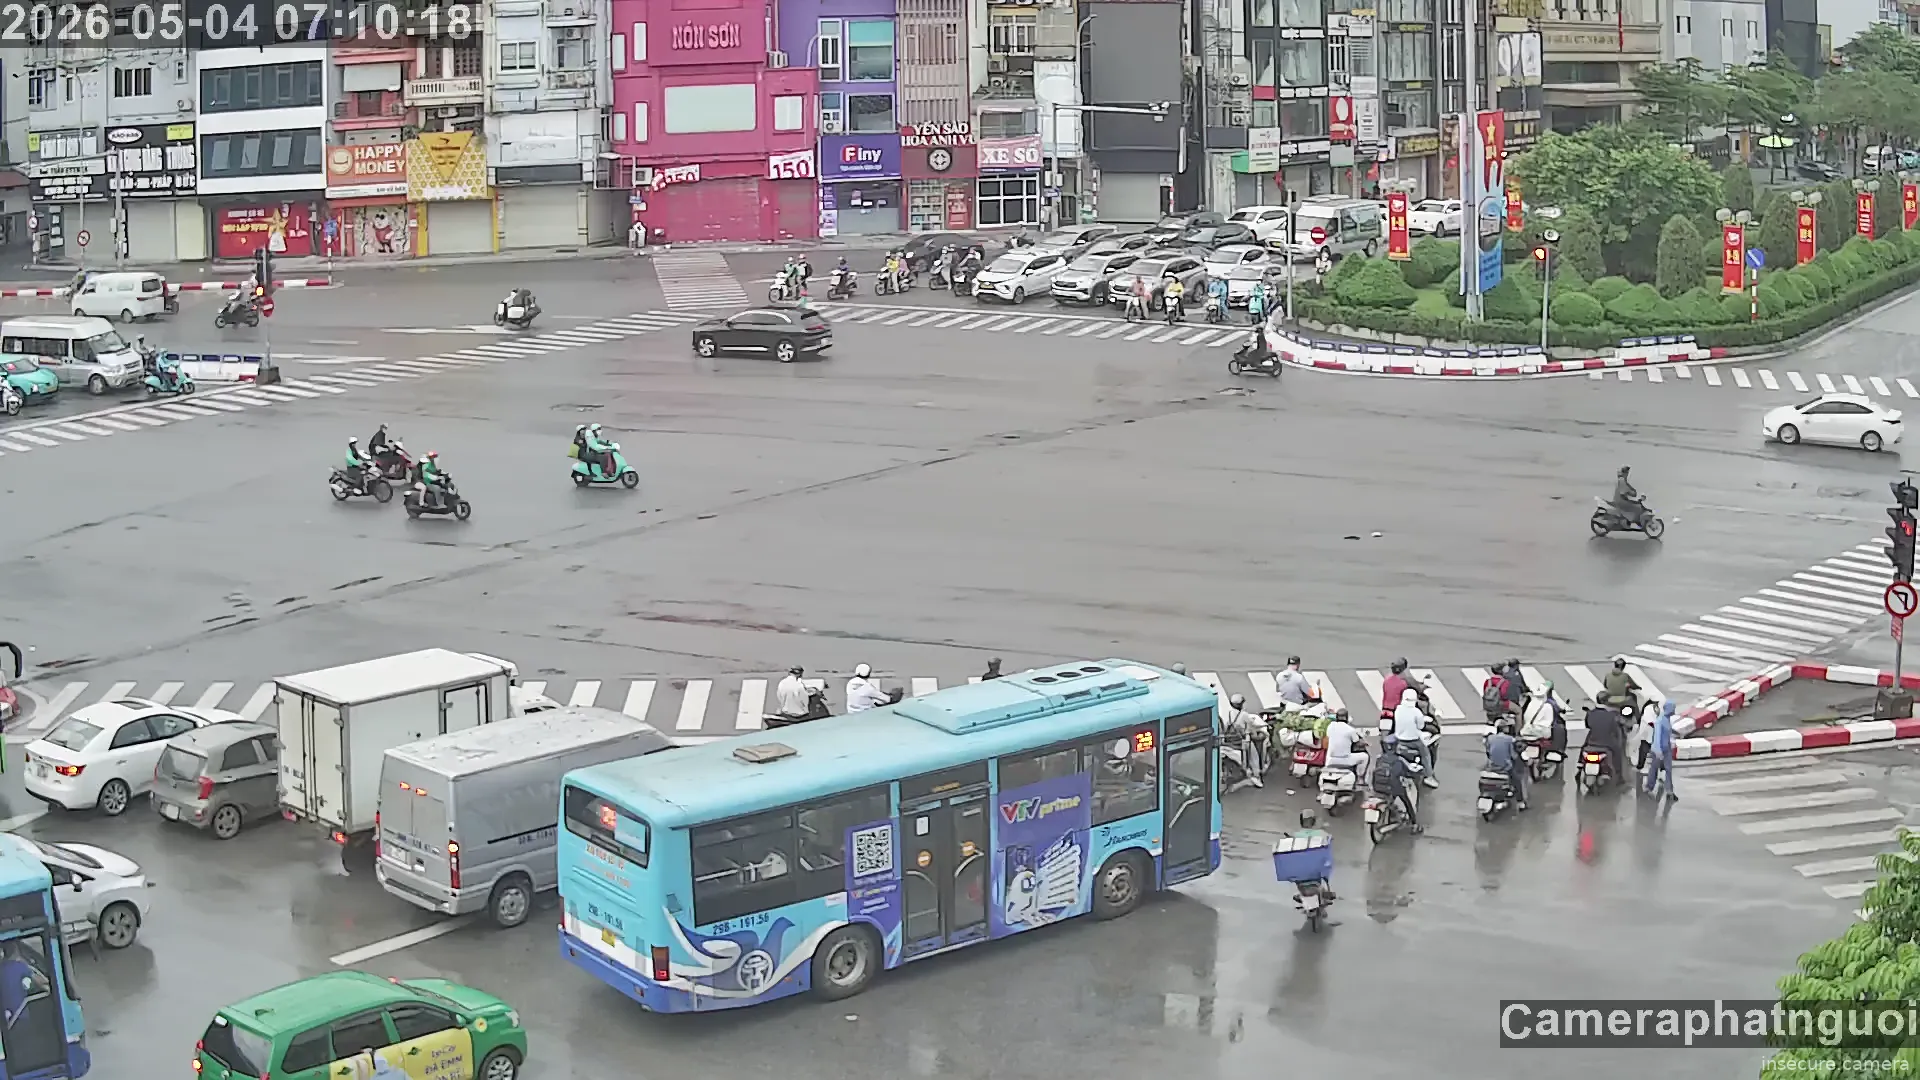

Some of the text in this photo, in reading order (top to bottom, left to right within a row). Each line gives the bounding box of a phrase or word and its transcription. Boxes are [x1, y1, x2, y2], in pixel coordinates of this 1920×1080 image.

[672, 20, 740, 49] NÓN SƠN
[354, 144, 404, 160] HAPPY
[982, 147, 1010, 165] XE
[354, 159, 406, 175] MONEY
[773, 159, 810, 179] 150
[999, 795, 1042, 825] VTV
